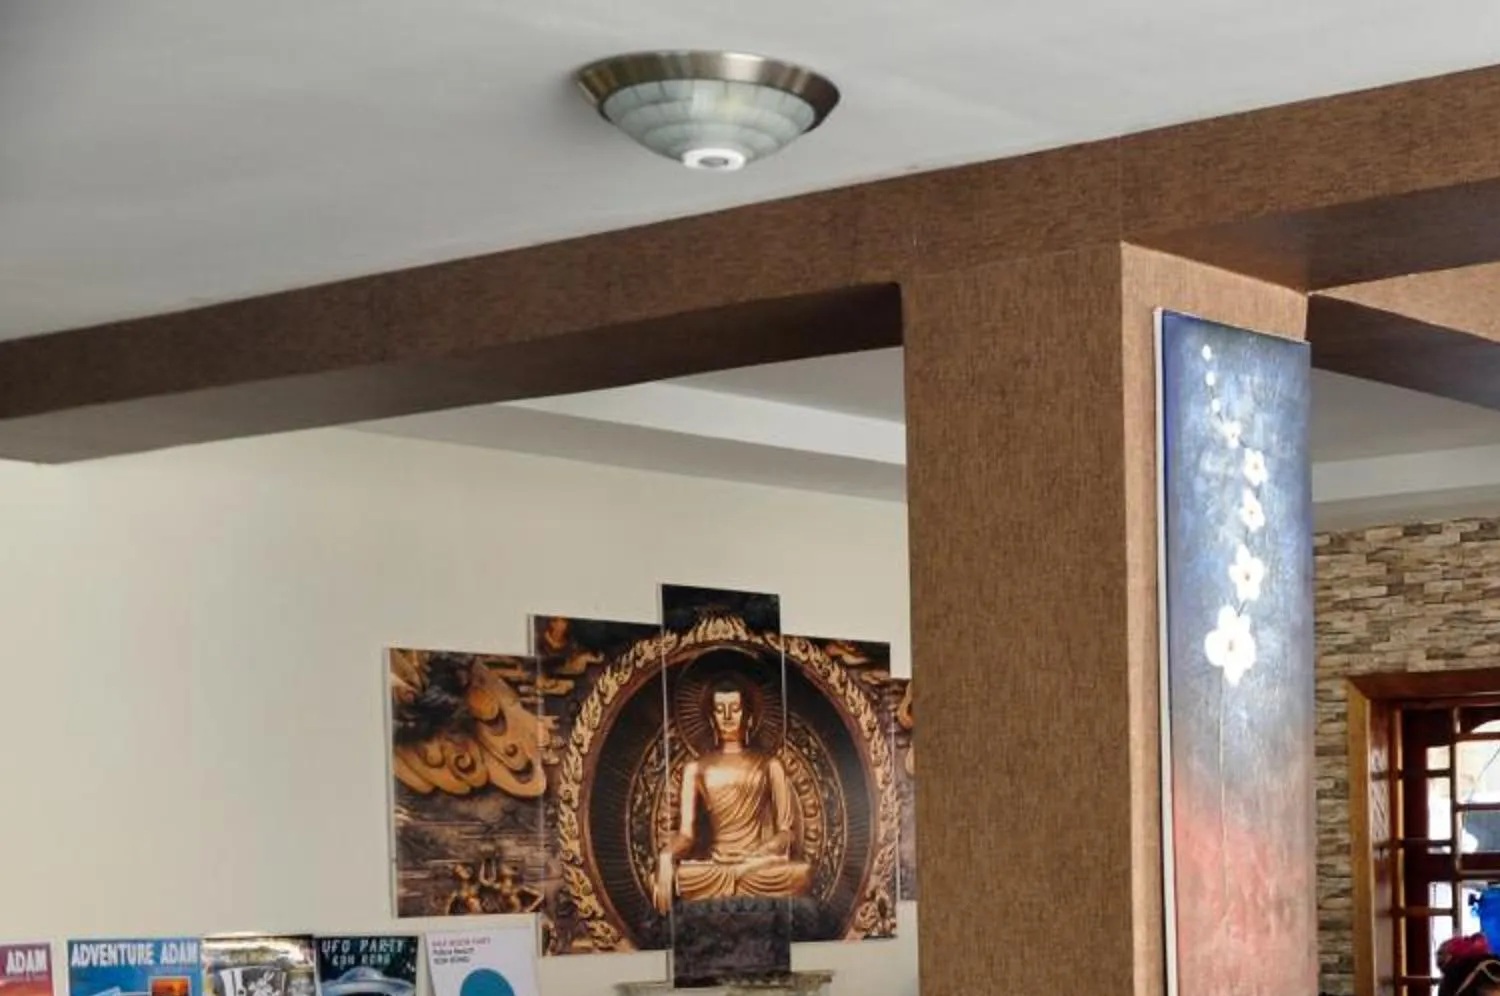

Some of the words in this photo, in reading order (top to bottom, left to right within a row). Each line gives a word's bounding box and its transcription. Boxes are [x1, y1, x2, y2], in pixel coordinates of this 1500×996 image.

[71, 943, 156, 968] ADVENTURE
[160, 942, 199, 966] ADAM
[321, 939, 351, 954] UFO
[360, 938, 405, 953] PARTY
[6, 948, 48, 975] ADAM
